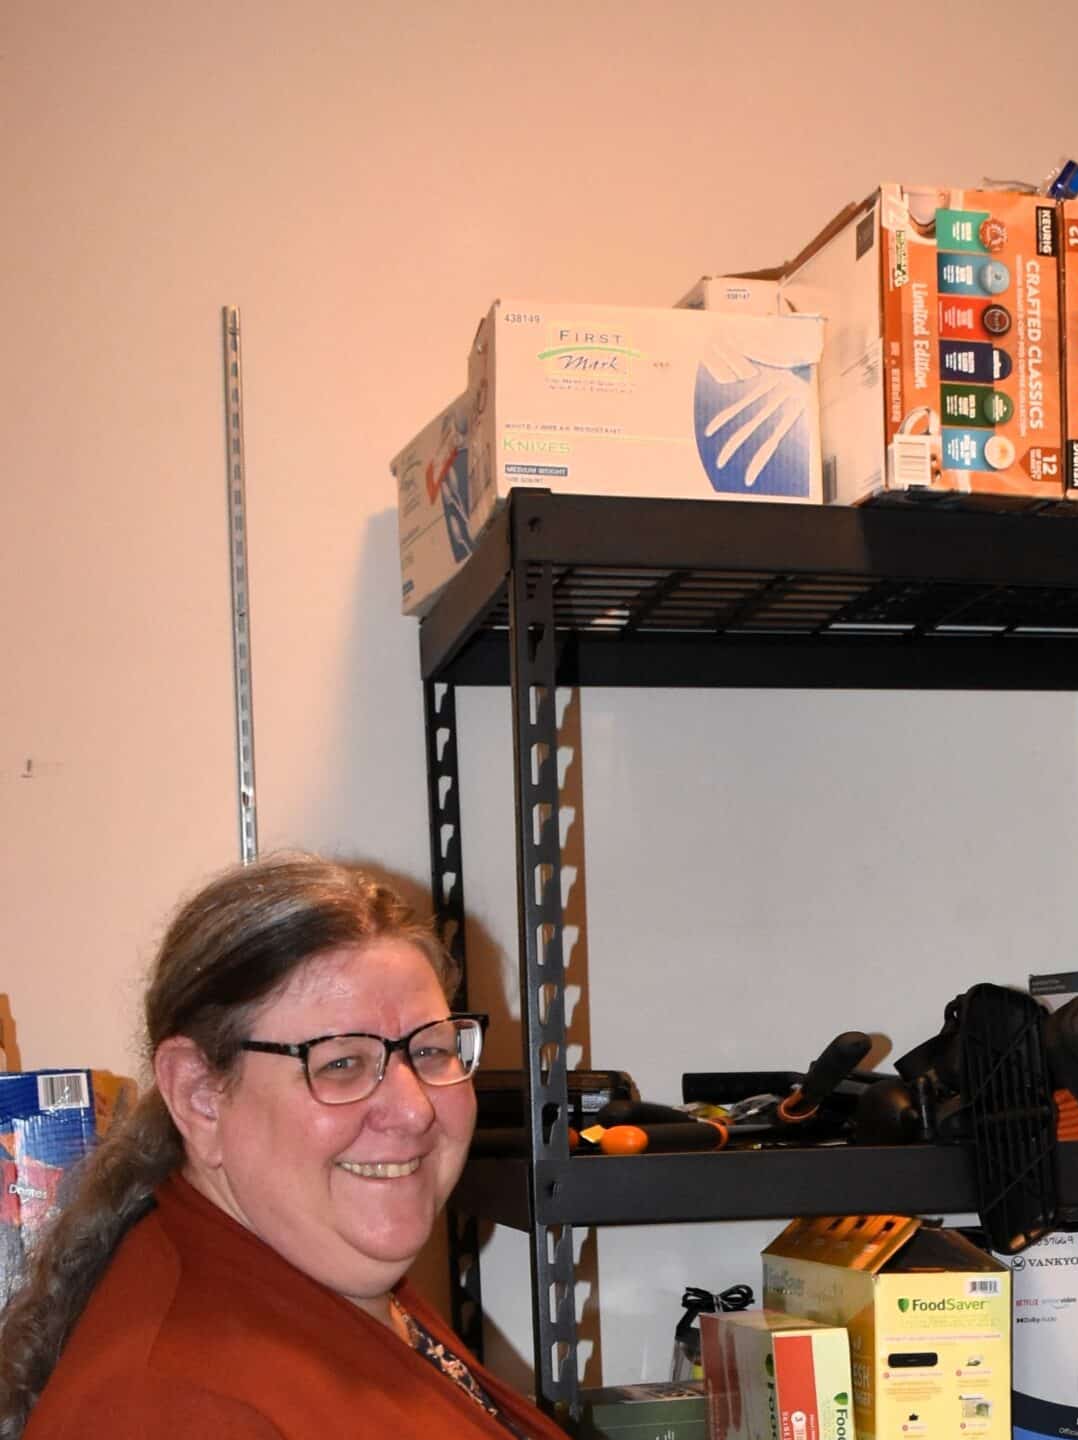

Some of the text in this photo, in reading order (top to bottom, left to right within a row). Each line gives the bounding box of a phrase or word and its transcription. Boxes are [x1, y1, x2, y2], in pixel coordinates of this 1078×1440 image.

[1041, 209, 1052, 254] KEURIG
[504, 313, 540, 323] 438149
[559, 329, 623, 344] FIRST
[912, 282, 931, 389] Limited Edition
[1025, 259, 1043, 430] CRAFTED CLASSICS
[503, 436, 571, 454] KNIVES
[1042, 454, 1057, 475] 12
[911, 1298, 985, 1312] FoodSaver
